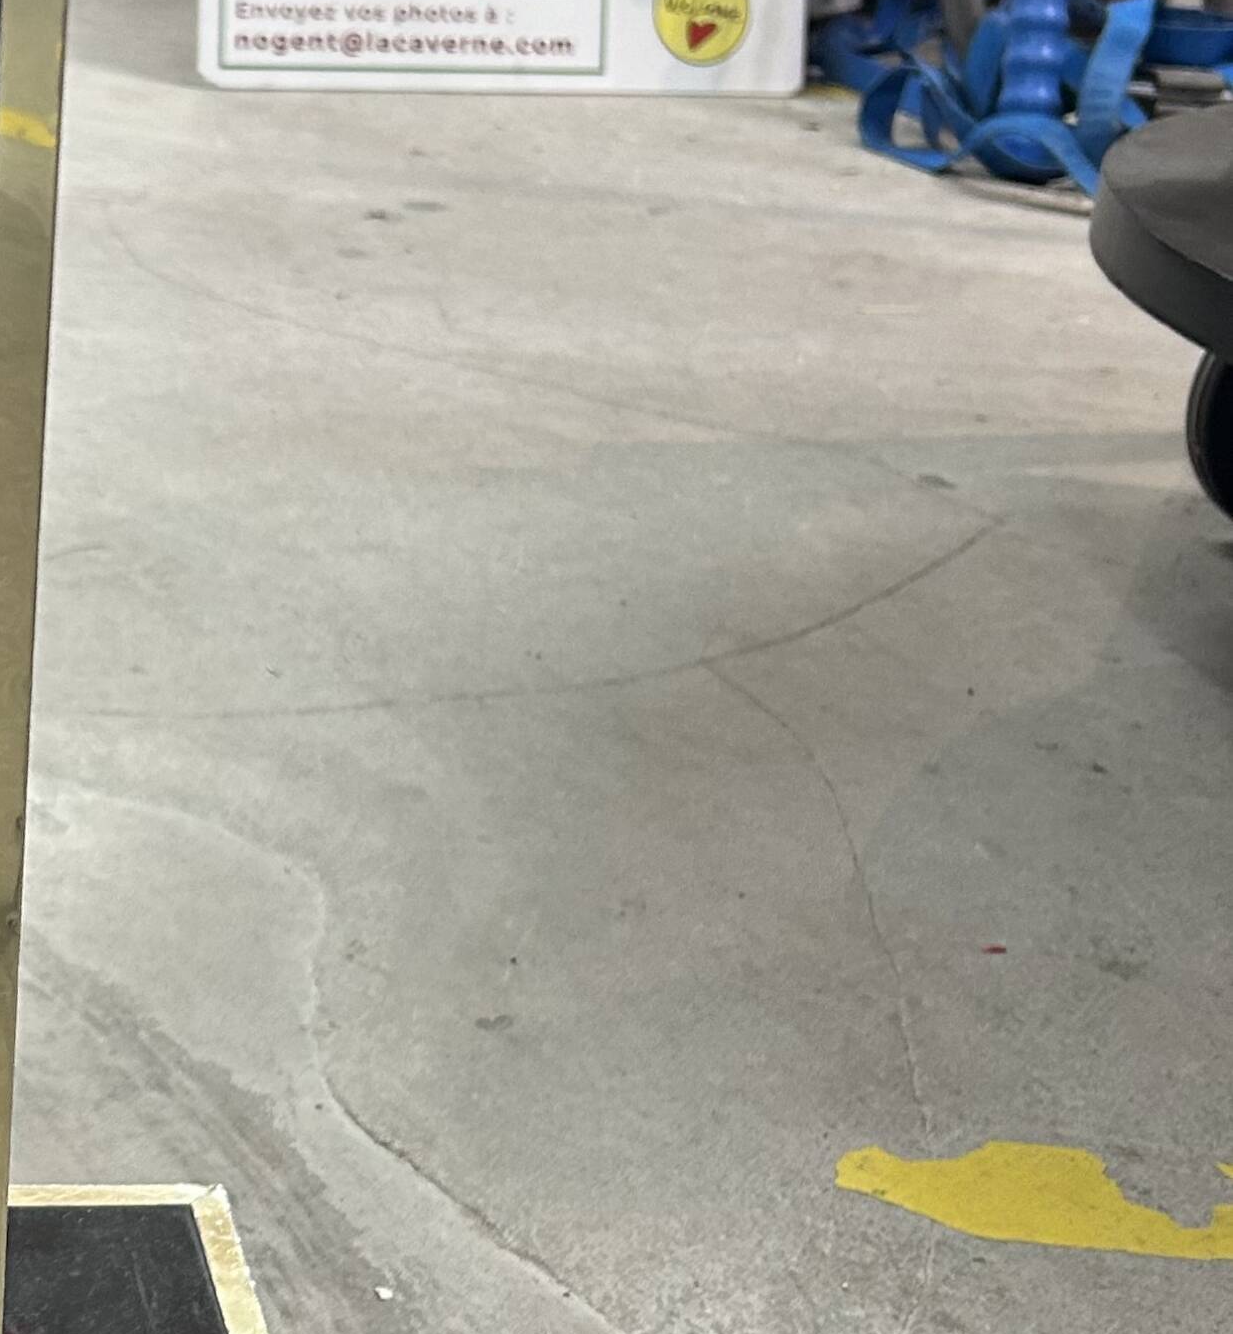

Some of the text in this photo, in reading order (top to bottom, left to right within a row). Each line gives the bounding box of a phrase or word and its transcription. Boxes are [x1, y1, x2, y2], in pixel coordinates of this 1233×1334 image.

[235, 0, 336, 25] Envoyez
[345, 5, 386, 23] vos
[393, 2, 478, 27] photos
[234, 29, 576, 58] nogent@lacaverne.com
